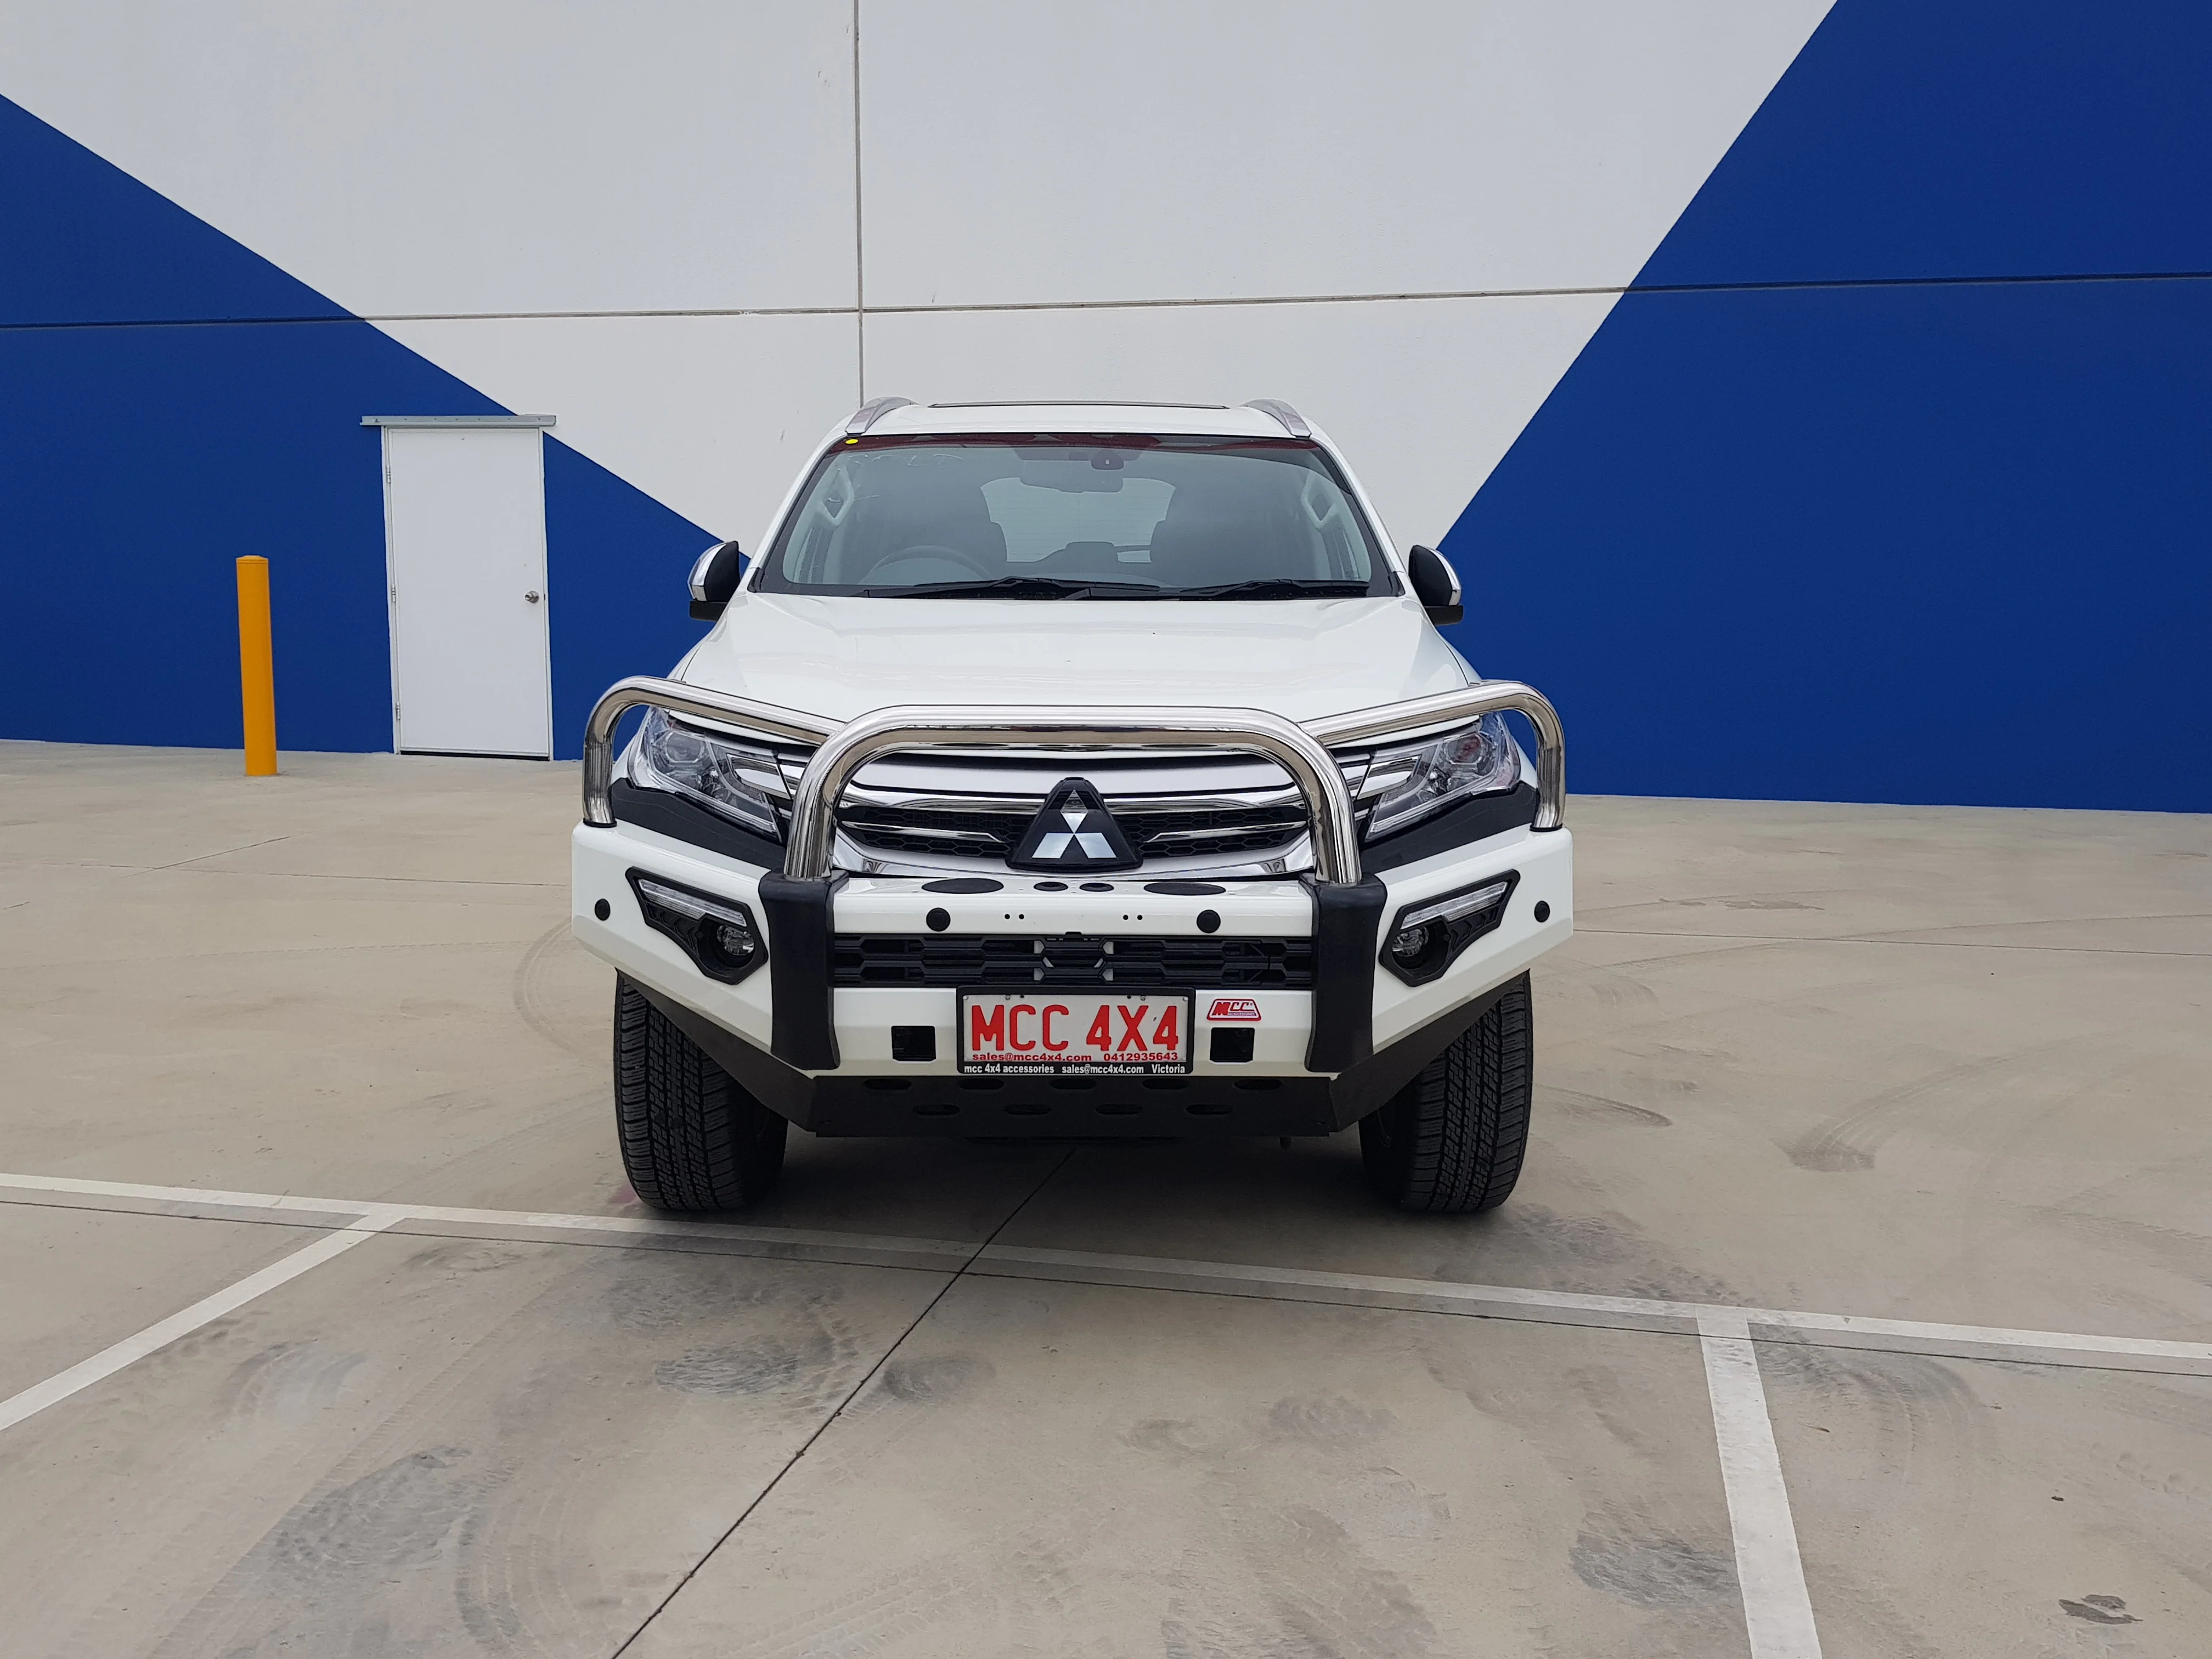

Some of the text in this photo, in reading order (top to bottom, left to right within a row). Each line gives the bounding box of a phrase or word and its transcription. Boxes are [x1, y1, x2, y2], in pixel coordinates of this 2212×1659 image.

[972, 1005, 1178, 1051] MCC 4X4
[973, 1052, 1178, 1061] sales@mcc4x4.com 0412935643
[985, 1063, 1001, 1073] 4x4
[1003, 1064, 1054, 1073] accessories
[1062, 1064, 1144, 1074] sales@mcc4x4.com
[1151, 1064, 1185, 1074] Victoria
